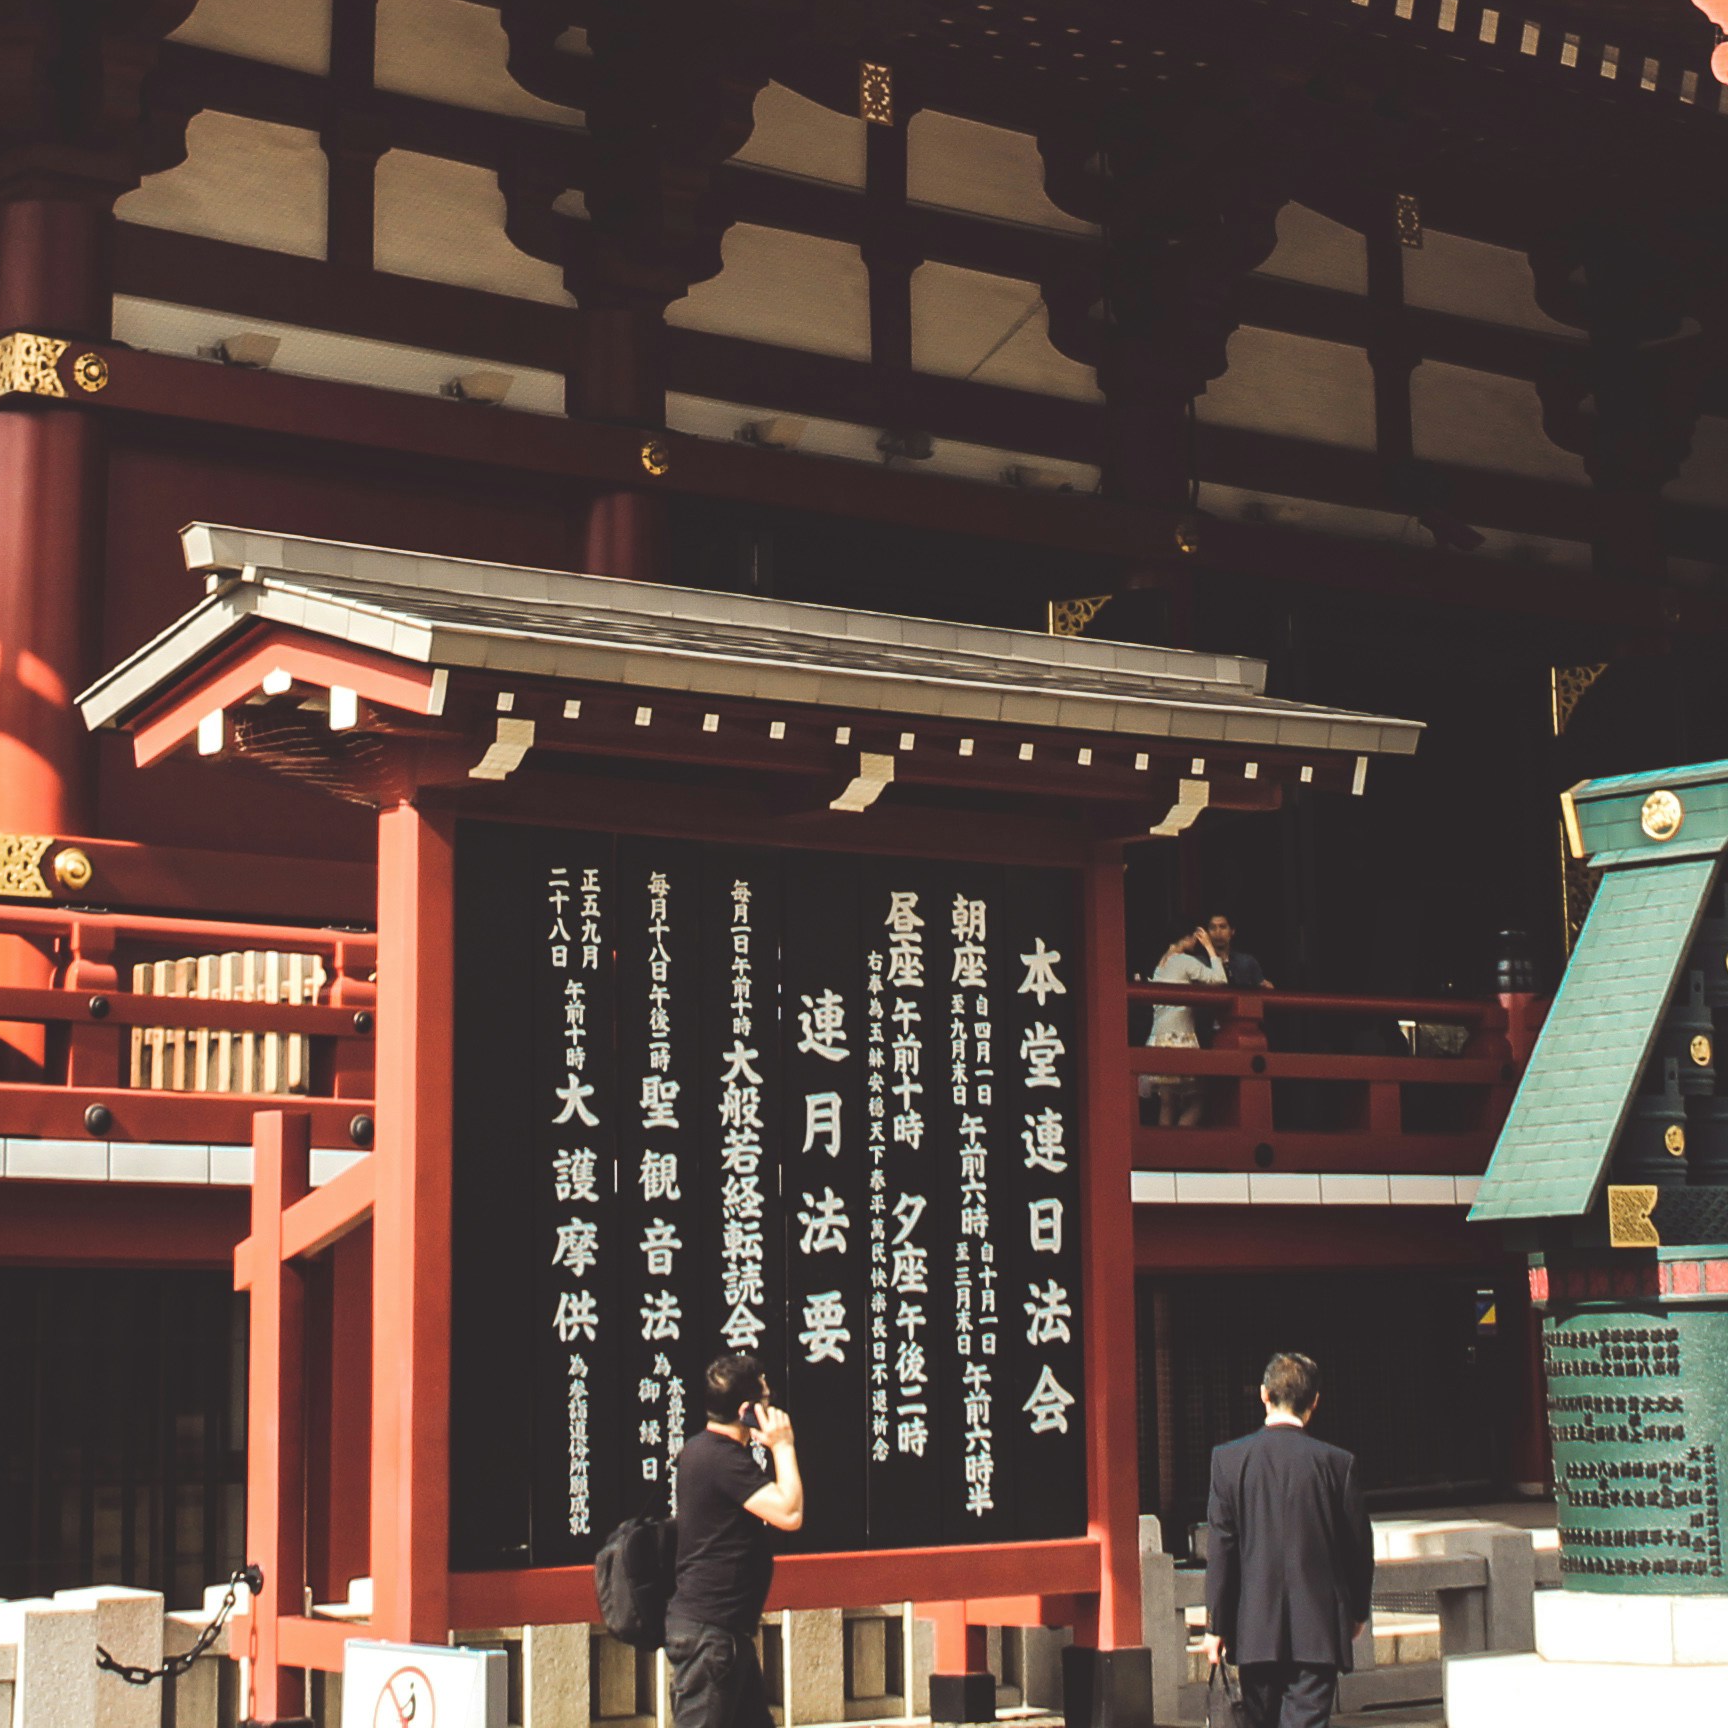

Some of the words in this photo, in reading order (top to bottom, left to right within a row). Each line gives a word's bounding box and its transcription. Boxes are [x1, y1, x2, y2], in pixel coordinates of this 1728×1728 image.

[797, 988, 851, 1363] 連月法要
[1017, 937, 1075, 1434] 本堂連日法会
